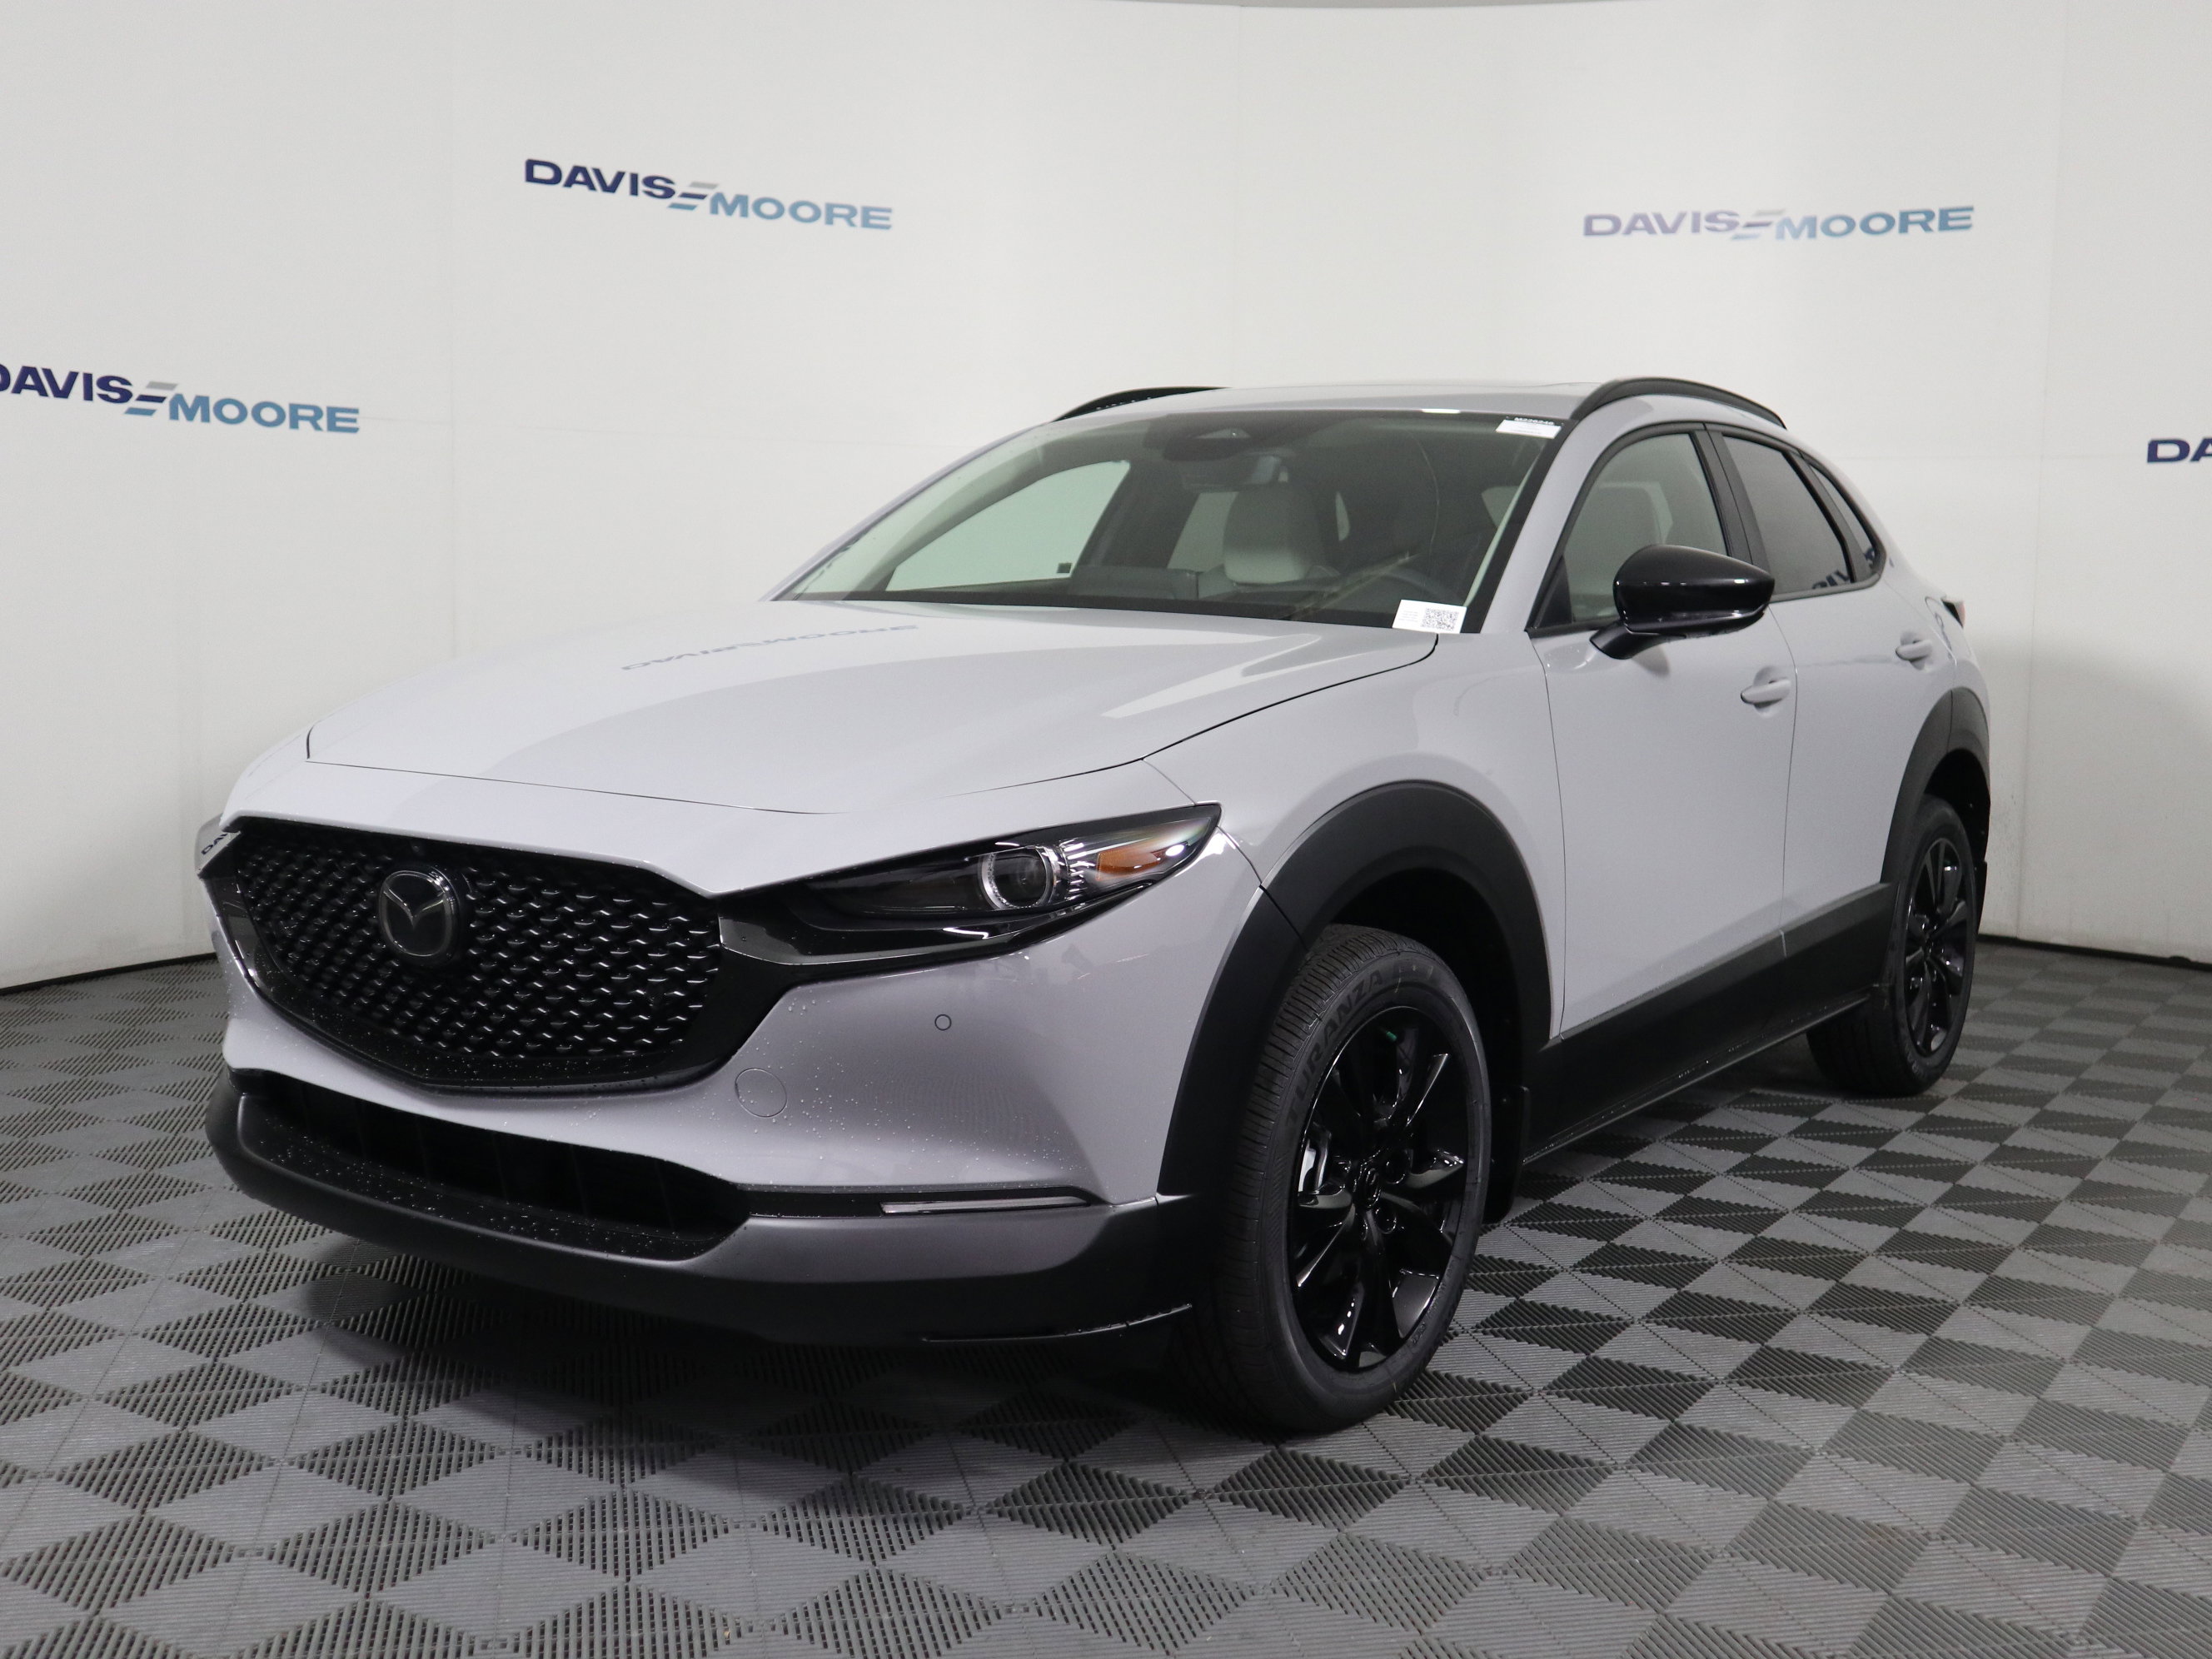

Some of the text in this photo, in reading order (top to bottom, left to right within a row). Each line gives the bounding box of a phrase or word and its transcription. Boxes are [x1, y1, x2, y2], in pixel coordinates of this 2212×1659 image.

[525, 158, 892, 230] DAVIS MOORE
[1583, 206, 1975, 240] DAVIS MOORE
[169, 393, 360, 433] MOORE
